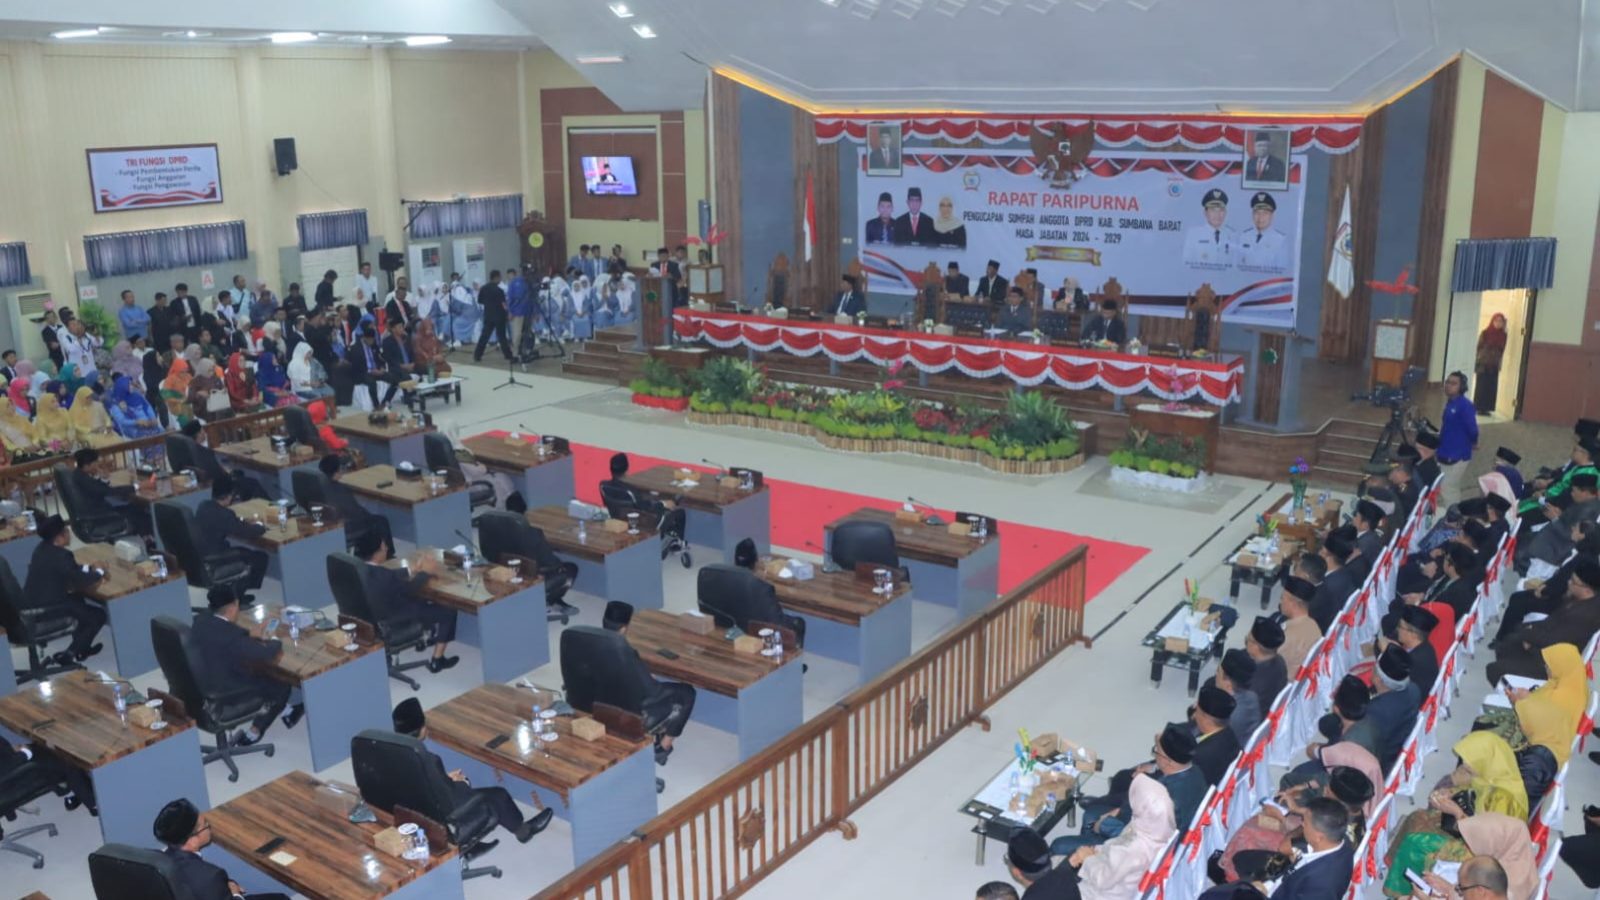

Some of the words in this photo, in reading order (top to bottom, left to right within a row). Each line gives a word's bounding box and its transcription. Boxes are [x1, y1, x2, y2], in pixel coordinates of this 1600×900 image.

[125, 158, 138, 167] TRI
[140, 156, 166, 166] FUNGSI
[168, 156, 188, 164] DPRD
[988, 192, 1038, 207] RAPAT
[1042, 194, 1140, 211] PARIPURNA
[963, 211, 1004, 222] PENGUCAPAN
[1008, 213, 1035, 224] SUMPAH
[1039, 215, 1069, 226] ANGGOTA
[1074, 216, 1093, 227] DPRD
[1098, 218, 1114, 228] KAB.
[1119, 218, 1153, 230] SUMBAWA
[1158, 220, 1181, 231] BARAT
[1016, 228, 1034, 239] MASA
[1039, 230, 1068, 240] JABATAN
[1072, 231, 1090, 241] 2024
[1104, 233, 1122, 244] 2029
